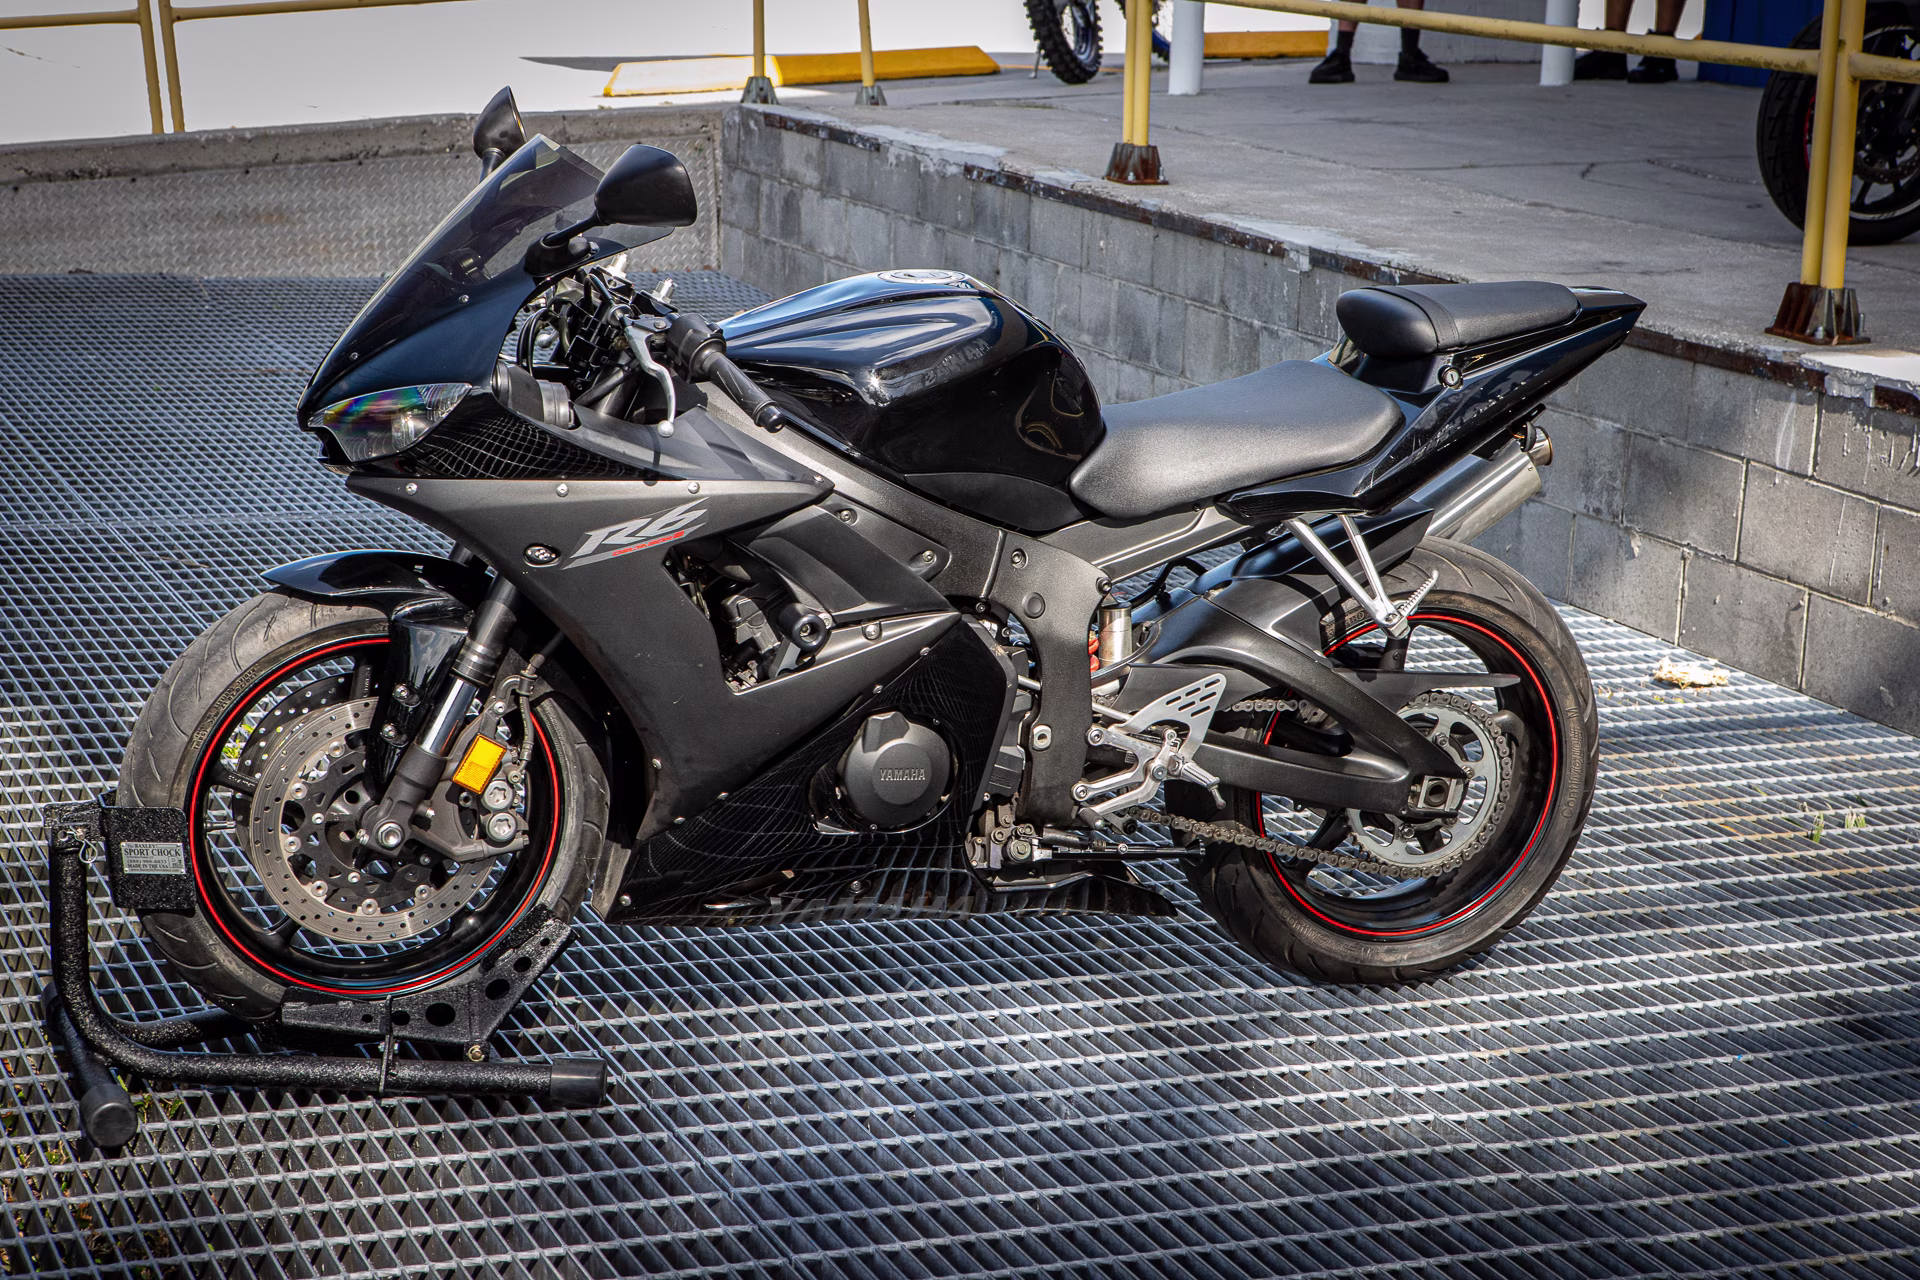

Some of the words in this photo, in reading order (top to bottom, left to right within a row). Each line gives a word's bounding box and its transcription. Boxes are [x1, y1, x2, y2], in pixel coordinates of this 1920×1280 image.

[570, 497, 709, 559] R6
[880, 768, 925, 780] YAMAHA
[124, 848, 150, 856] SPORT
[151, 848, 181, 856] CHOCK
[770, 896, 974, 923] YAMAHA
